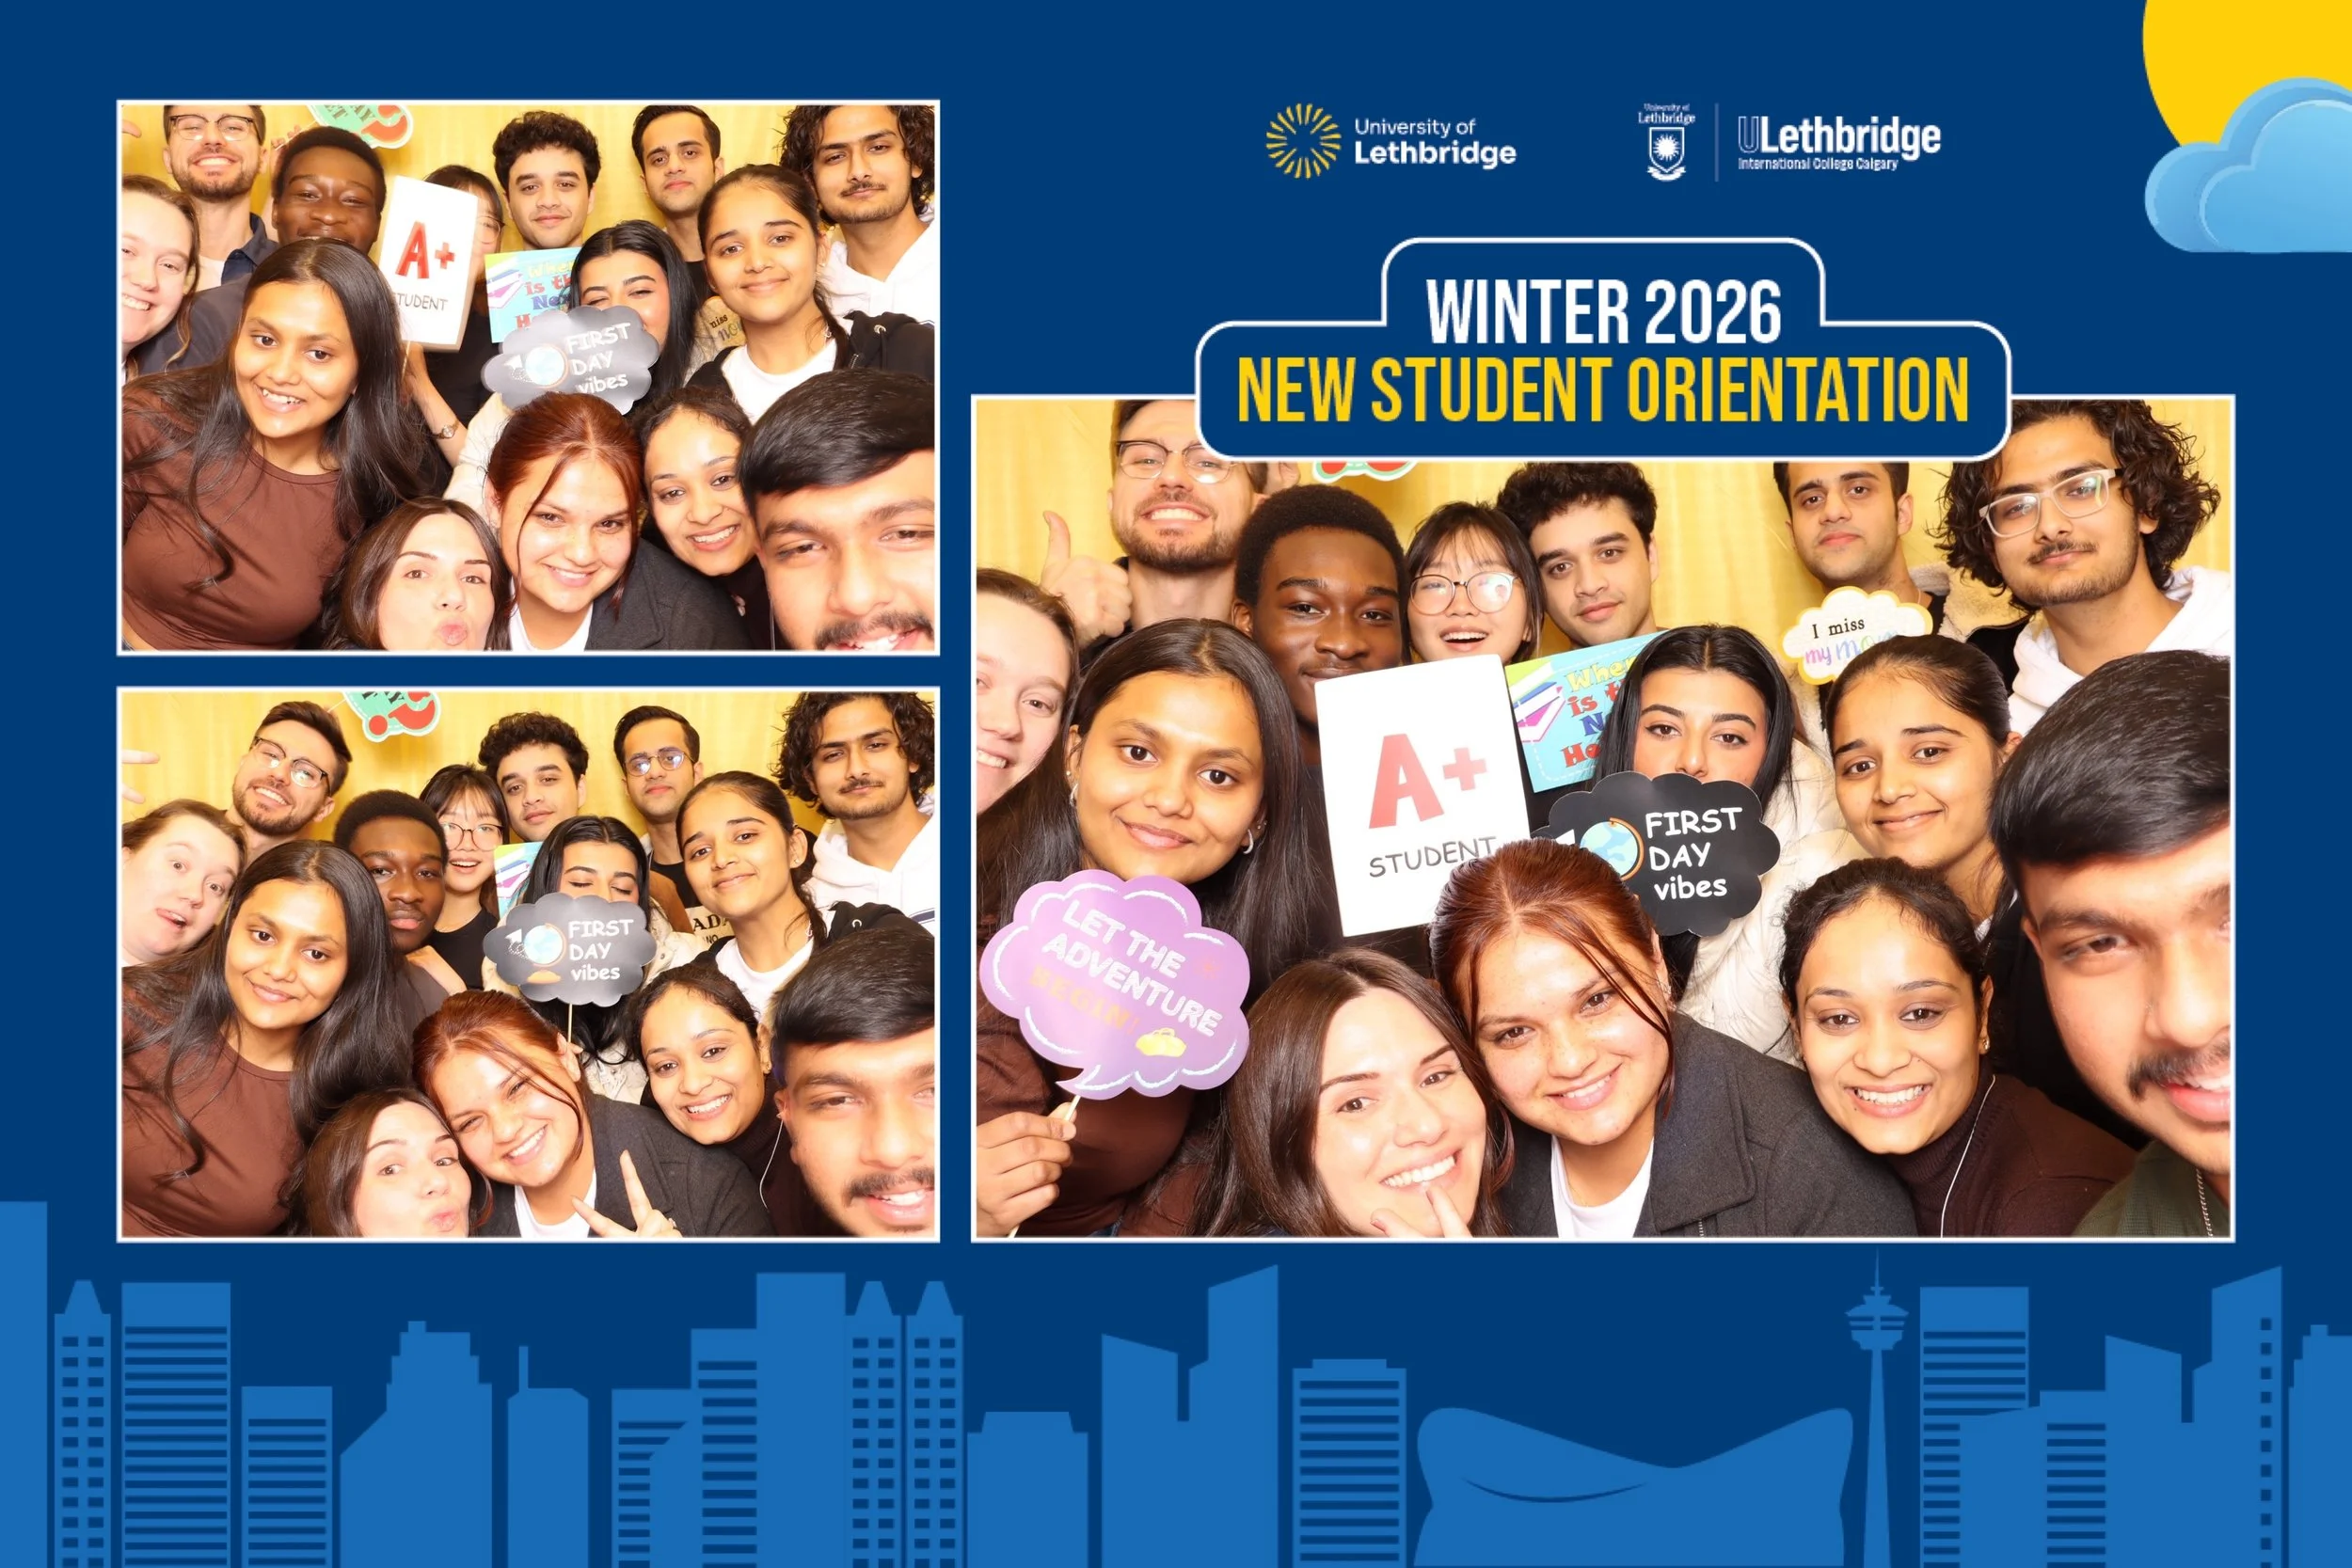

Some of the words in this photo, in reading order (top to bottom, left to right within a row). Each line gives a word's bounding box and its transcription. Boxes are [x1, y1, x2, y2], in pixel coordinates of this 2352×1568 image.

[395, 220, 456, 279] A+
[525, 280, 546, 296] is
[391, 292, 449, 311] TUDENT
[566, 322, 631, 355] FIRST
[570, 350, 614, 376] DAY
[576, 373, 629, 394] vibes
[1812, 624, 1819, 640] I
[1828, 618, 1866, 637] miss
[1804, 644, 1833, 666] my
[1566, 695, 1598, 719] is
[1368, 733, 1487, 830] A+
[1645, 806, 1743, 839] FIRST
[1369, 835, 1497, 879] STUDENT
[1648, 841, 1711, 872] DAY
[1653, 874, 1728, 901] vibes
[567, 918, 634, 939] FIRST
[1062, 898, 1126, 945] LET
[1125, 929, 1186, 979] THE
[569, 941, 612, 961] DAY
[570, 964, 621, 982] vibes
[1041, 932, 1223, 1037] ADVENTURE
